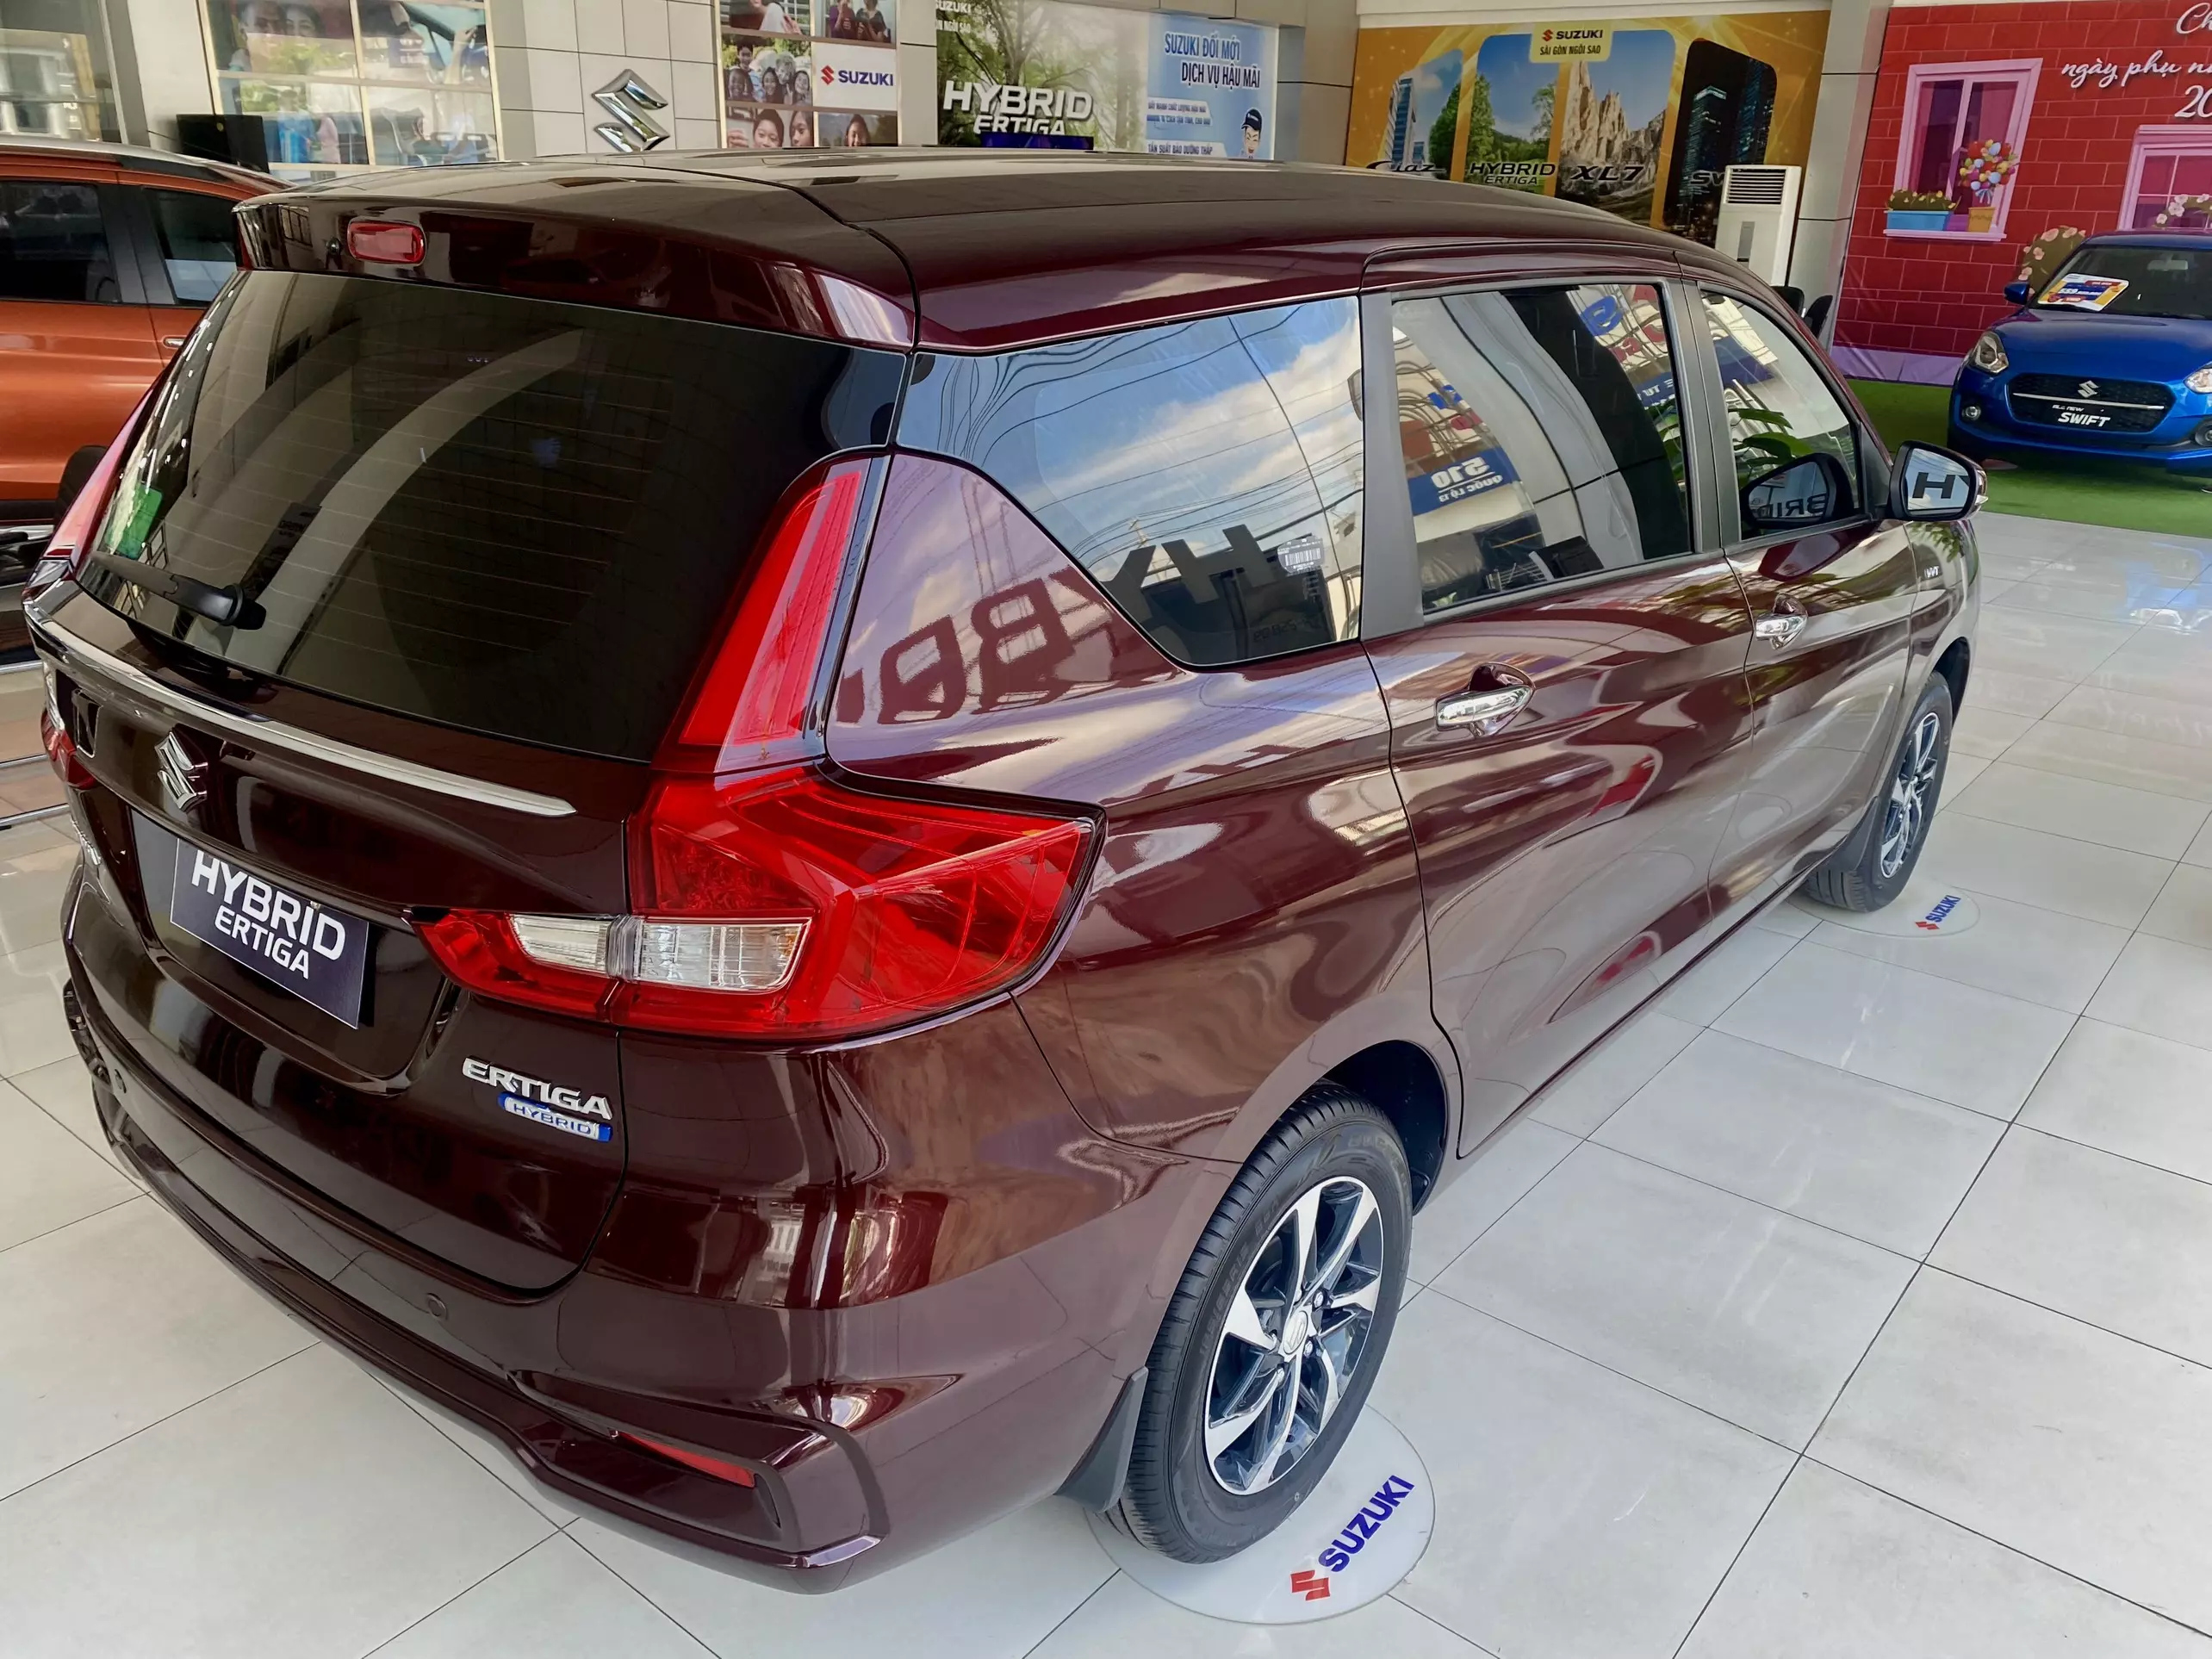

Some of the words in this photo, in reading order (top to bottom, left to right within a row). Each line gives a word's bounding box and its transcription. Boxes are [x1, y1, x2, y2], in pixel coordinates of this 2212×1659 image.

[1165, 33, 1200, 56] SUZUKI
[1556, 29, 1604, 40] SUZUKI
[1569, 43, 1587, 54] NGÔI
[1588, 45, 1601, 54] SAO
[838, 70, 893, 86] SUZUKI
[1181, 62, 1204, 86] DỊCH
[1208, 65, 1220, 88] VỤ
[1222, 63, 1241, 90] HẬU
[1243, 65, 1260, 89] MÃI
[2061, 57, 2118, 88] ngày
[2121, 49, 2183, 88] phụ
[943, 80, 1092, 120] HYBRID
[973, 115, 1066, 135] ERTIGA
[1469, 162, 1556, 176] HYBRID
[1484, 175, 1538, 185] ERTIGA
[1570, 165, 1643, 181] XL7
[2058, 412, 2111, 427] SWIFT
[191, 849, 345, 960] HYBRID
[1925, 894, 1961, 923] SUZUKI
[214, 904, 309, 980] ERTIGA
[462, 1057, 613, 1120] ERTIGA
[513, 1102, 592, 1135] HYBRID
[1318, 1475, 1415, 1572] SUZUKI
